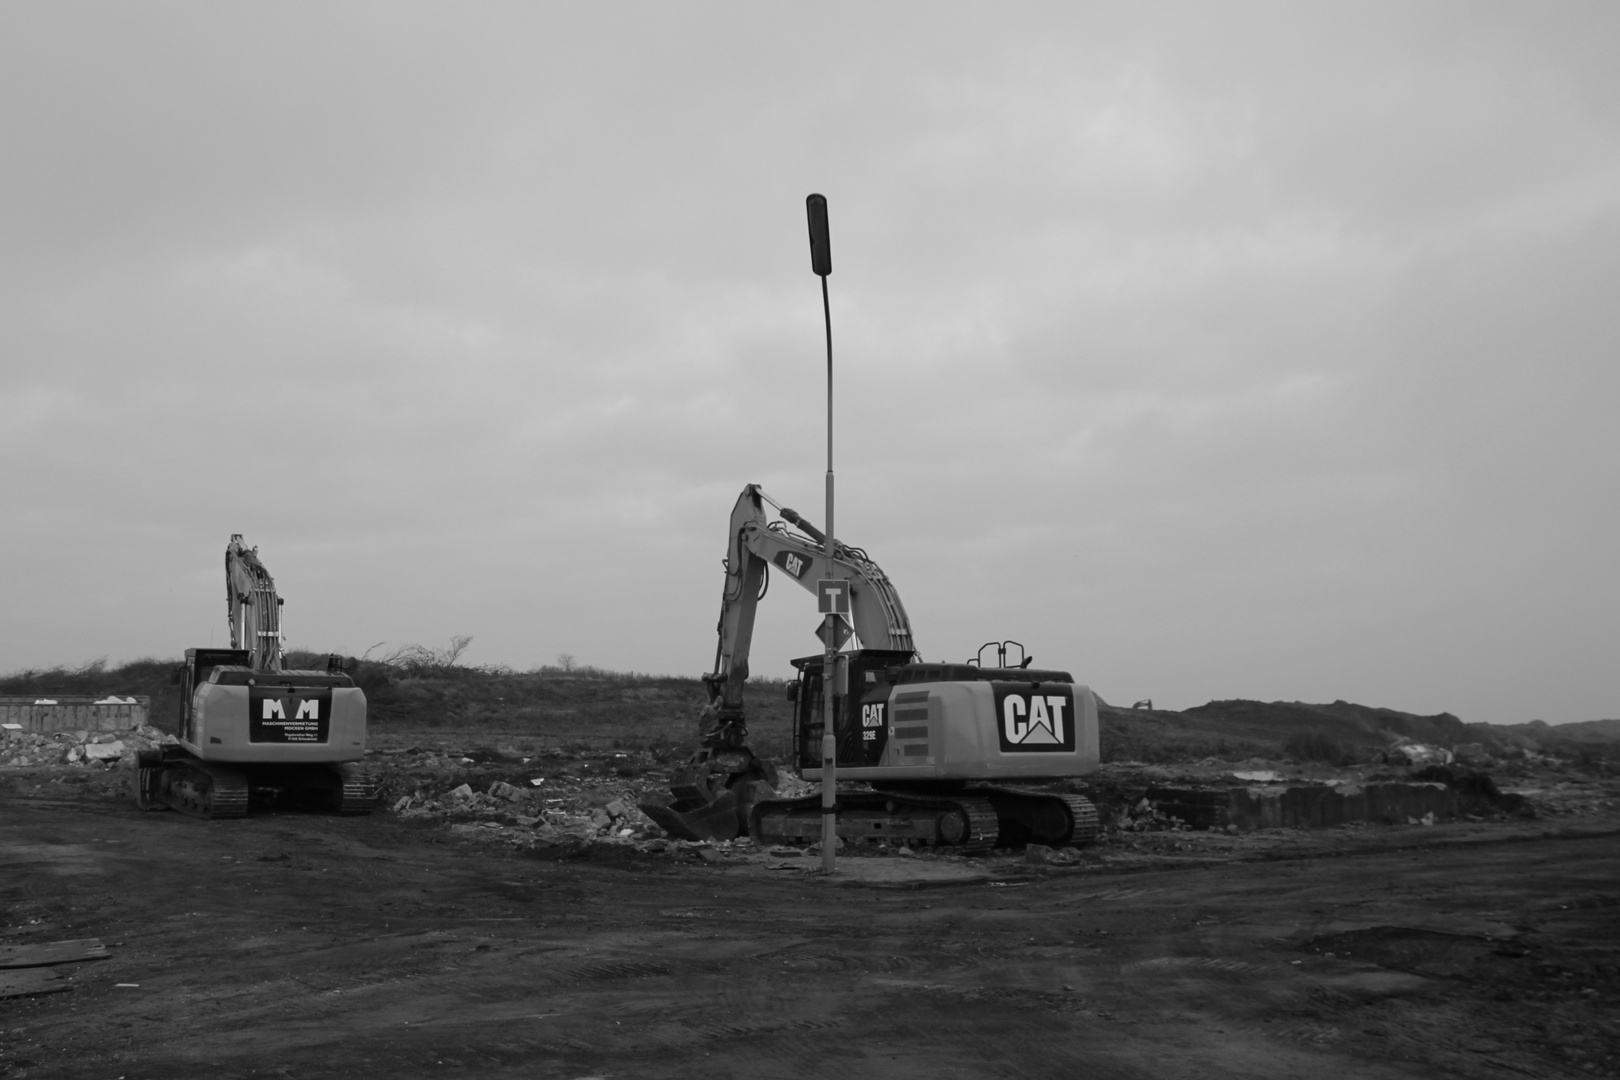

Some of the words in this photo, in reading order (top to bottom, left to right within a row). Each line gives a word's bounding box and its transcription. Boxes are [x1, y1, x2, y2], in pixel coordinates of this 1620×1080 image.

[785, 552, 803, 577] CAT
[262, 697, 319, 720] MVM
[862, 703, 884, 727] CAT
[1003, 694, 1067, 744] CAT
[862, 730, 876, 740] 329E
